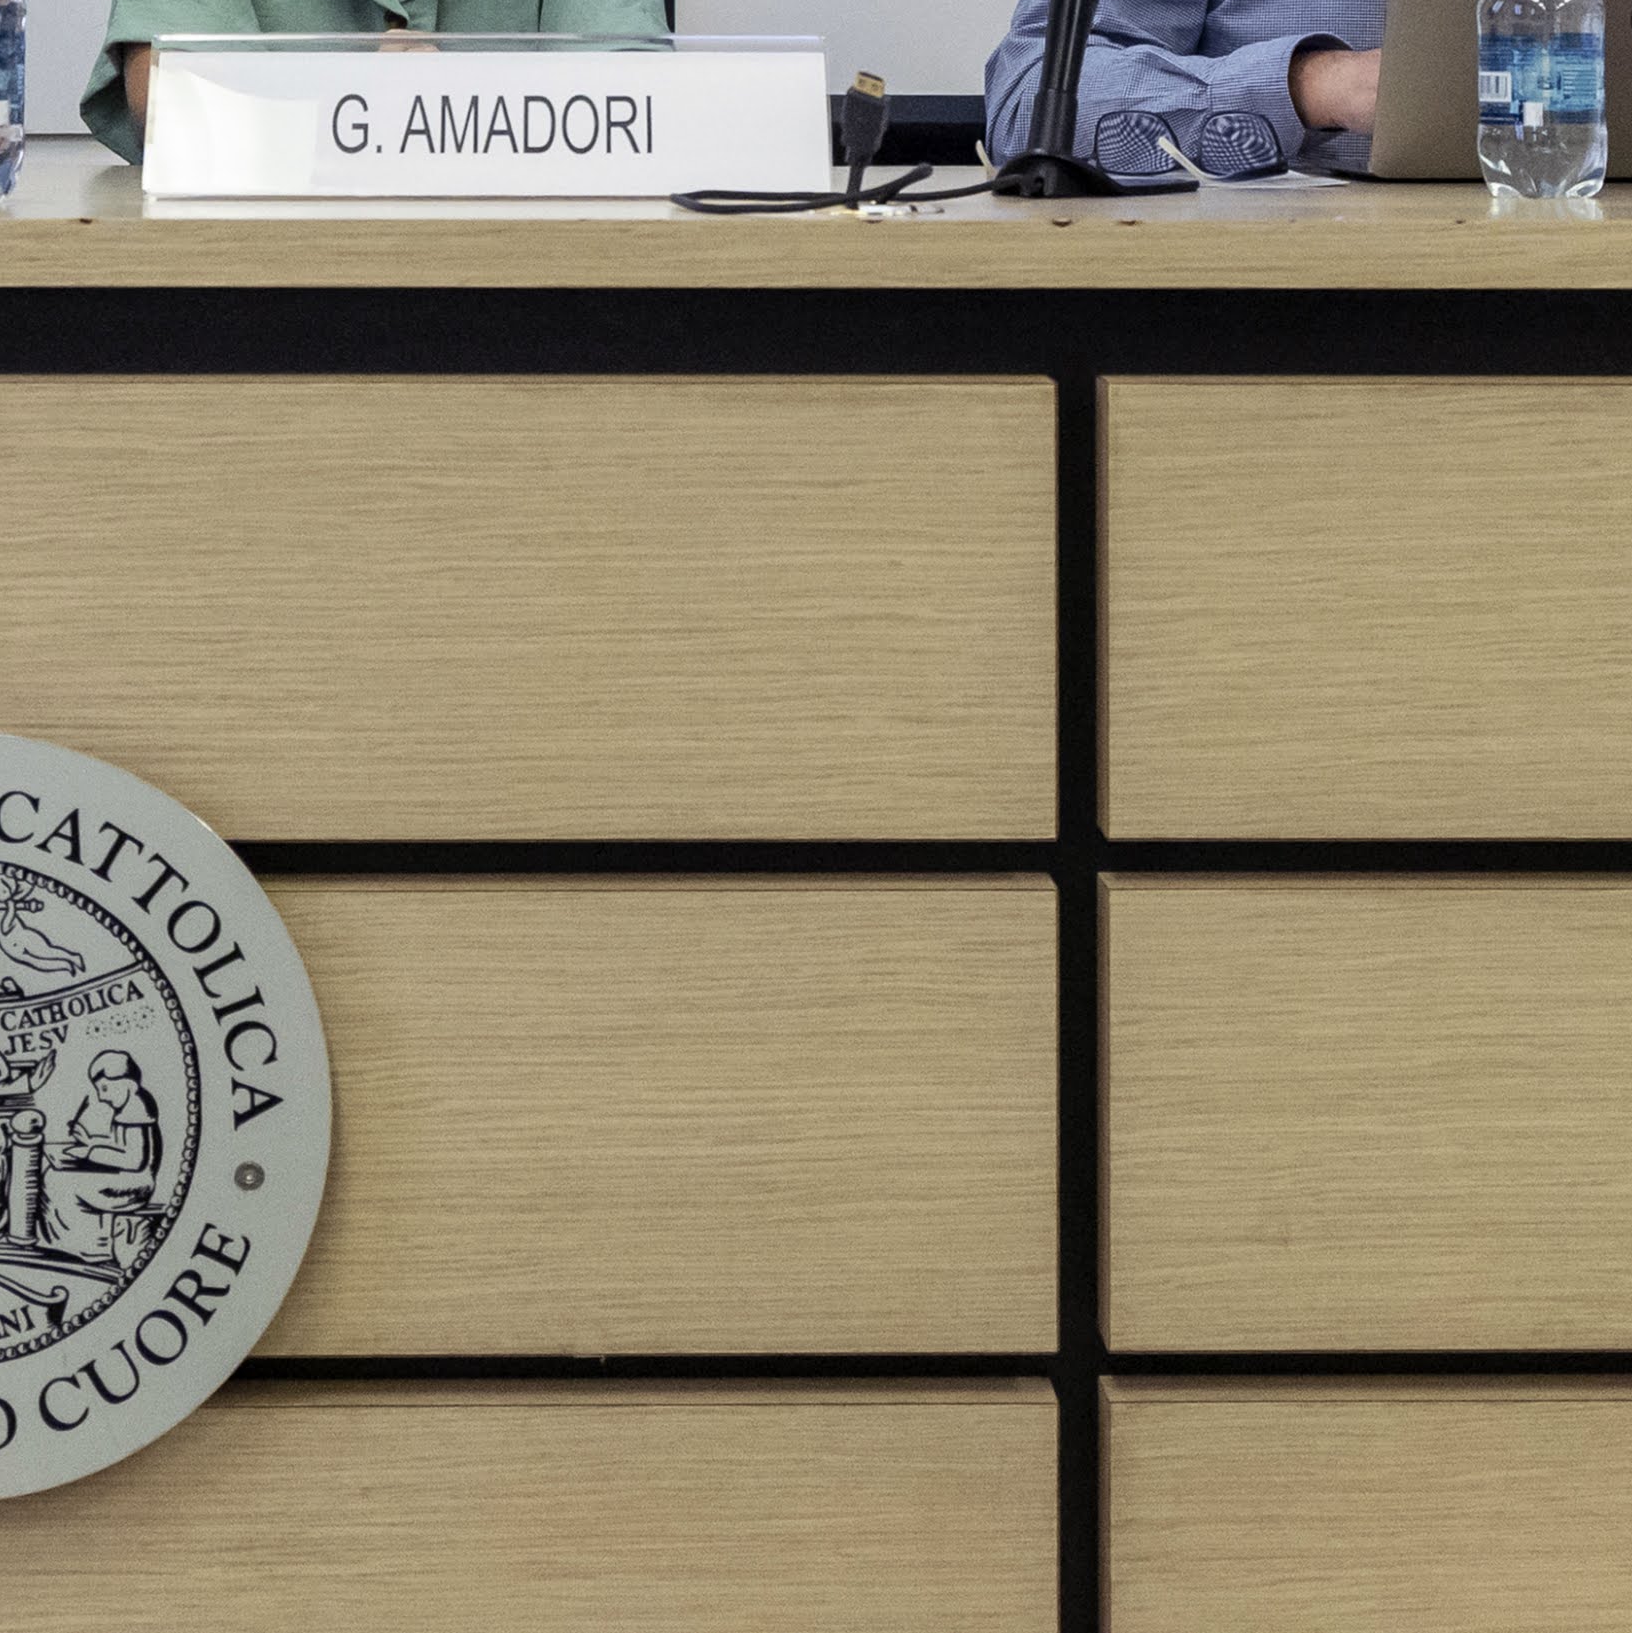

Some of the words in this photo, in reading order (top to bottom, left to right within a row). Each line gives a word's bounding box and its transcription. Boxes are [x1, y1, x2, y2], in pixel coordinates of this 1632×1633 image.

[332, 93, 383, 155] G.
[399, 94, 654, 156] AMADORI
[0, 979, 145, 1032] CATHOLICA
[38, 1222, 252, 1432] CUORE
